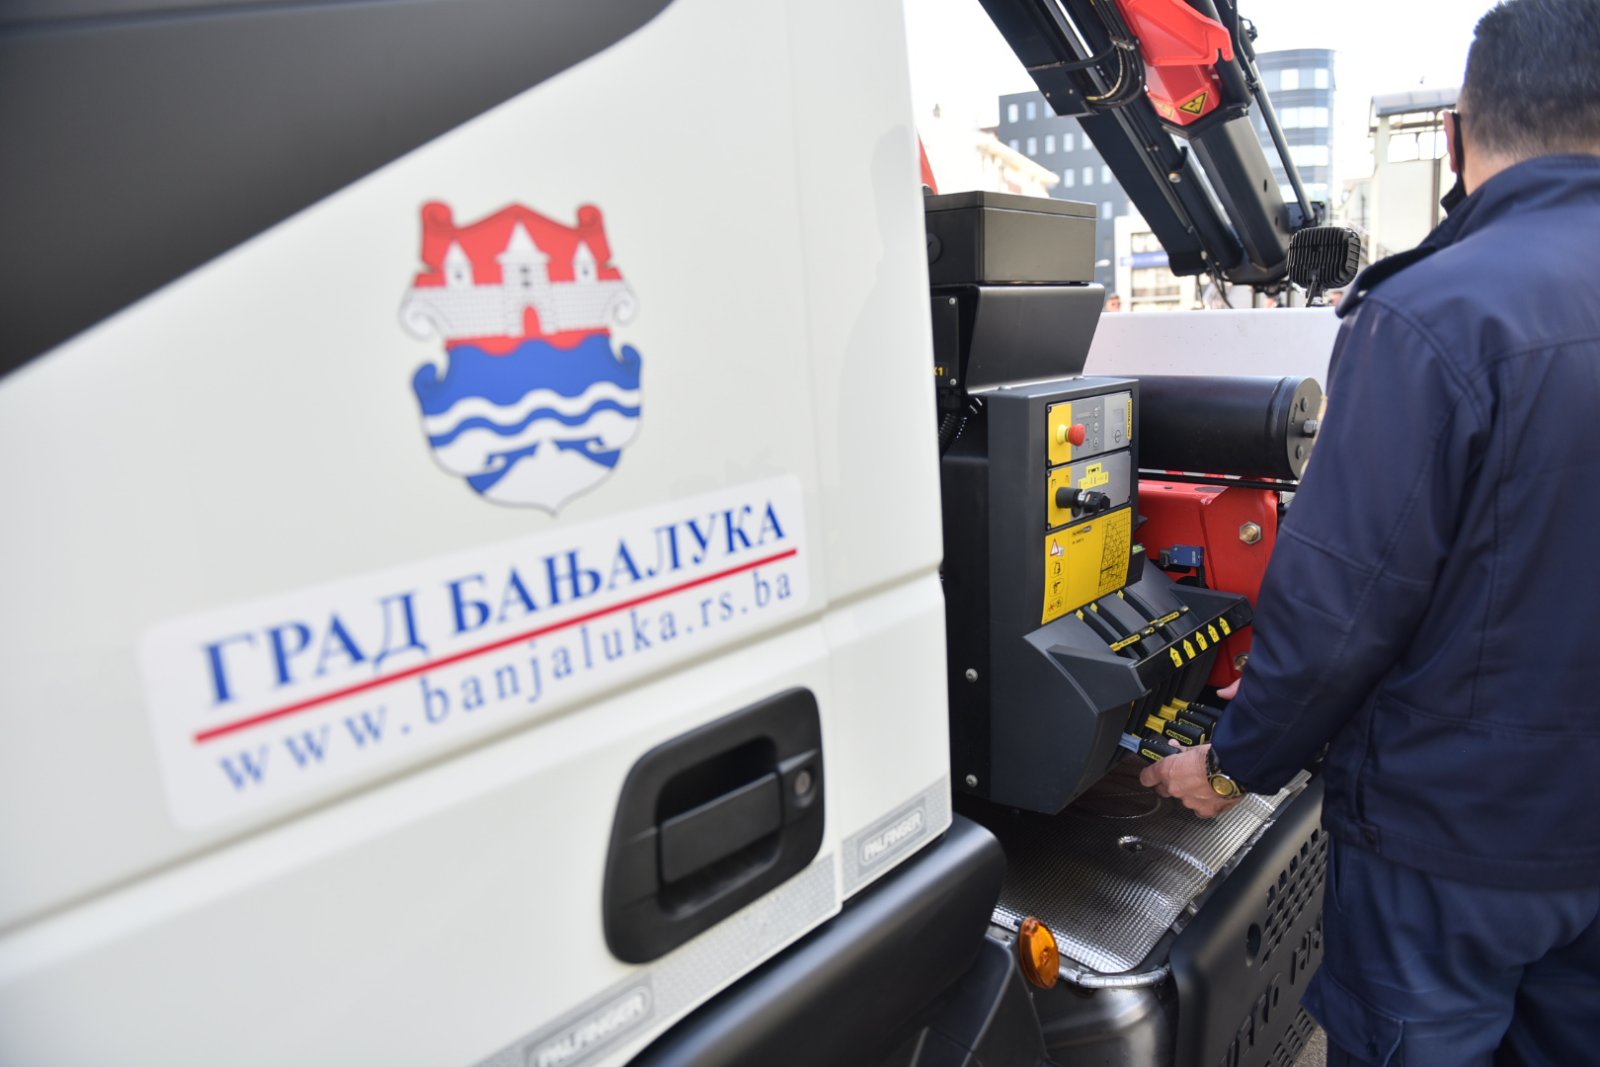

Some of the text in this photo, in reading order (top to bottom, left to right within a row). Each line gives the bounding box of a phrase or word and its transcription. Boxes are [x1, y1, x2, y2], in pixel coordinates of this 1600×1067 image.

[198, 499, 786, 708] ГРАД БАЊАЛУКА
[219, 570, 792, 791] www.banjaluka.rs.ba
[864, 811, 922, 861] PALFINGER
[537, 993, 645, 1067] PALFINGER
